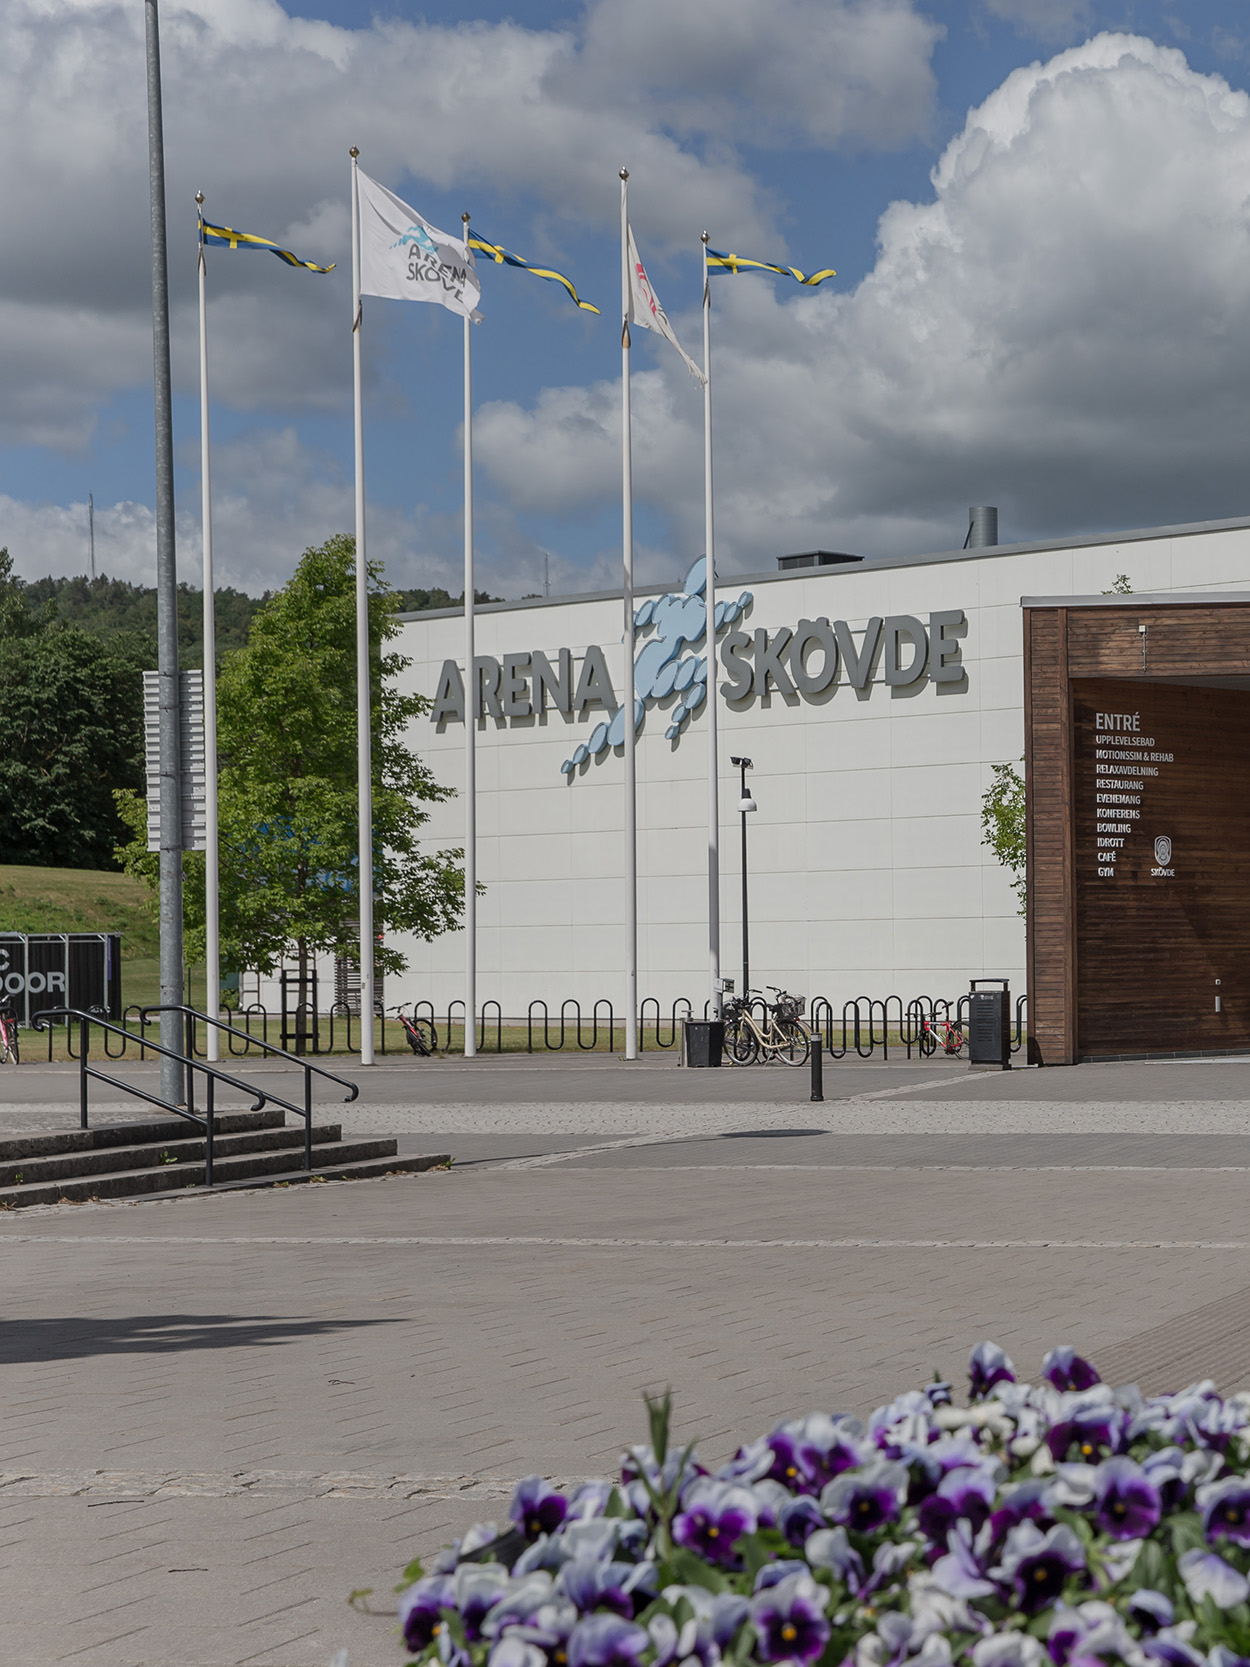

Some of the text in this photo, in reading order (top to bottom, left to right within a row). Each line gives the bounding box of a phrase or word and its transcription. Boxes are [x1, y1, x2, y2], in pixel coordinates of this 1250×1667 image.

[430, 609, 967, 723] ARENA SKÖVDE
[1096, 711, 1141, 732] ENTRÉ
[1096, 735, 1155, 747] UPPLEVELSEBAD
[1096, 750, 1142, 761] MOTIONSSIM
[1150, 753, 1174, 762] REHAB
[1096, 764, 1159, 776] RELAXAVDELNING
[1096, 779, 1144, 790] RESTAURANG
[1096, 793, 1141, 805] EVENEMANG
[1096, 808, 1140, 819] KONFERENS
[1097, 822, 1132, 833] BOWLING
[1097, 837, 1125, 848] IDROTT
[1098, 851, 1116, 862] CAFÉ
[1098, 867, 1114, 877] GYM
